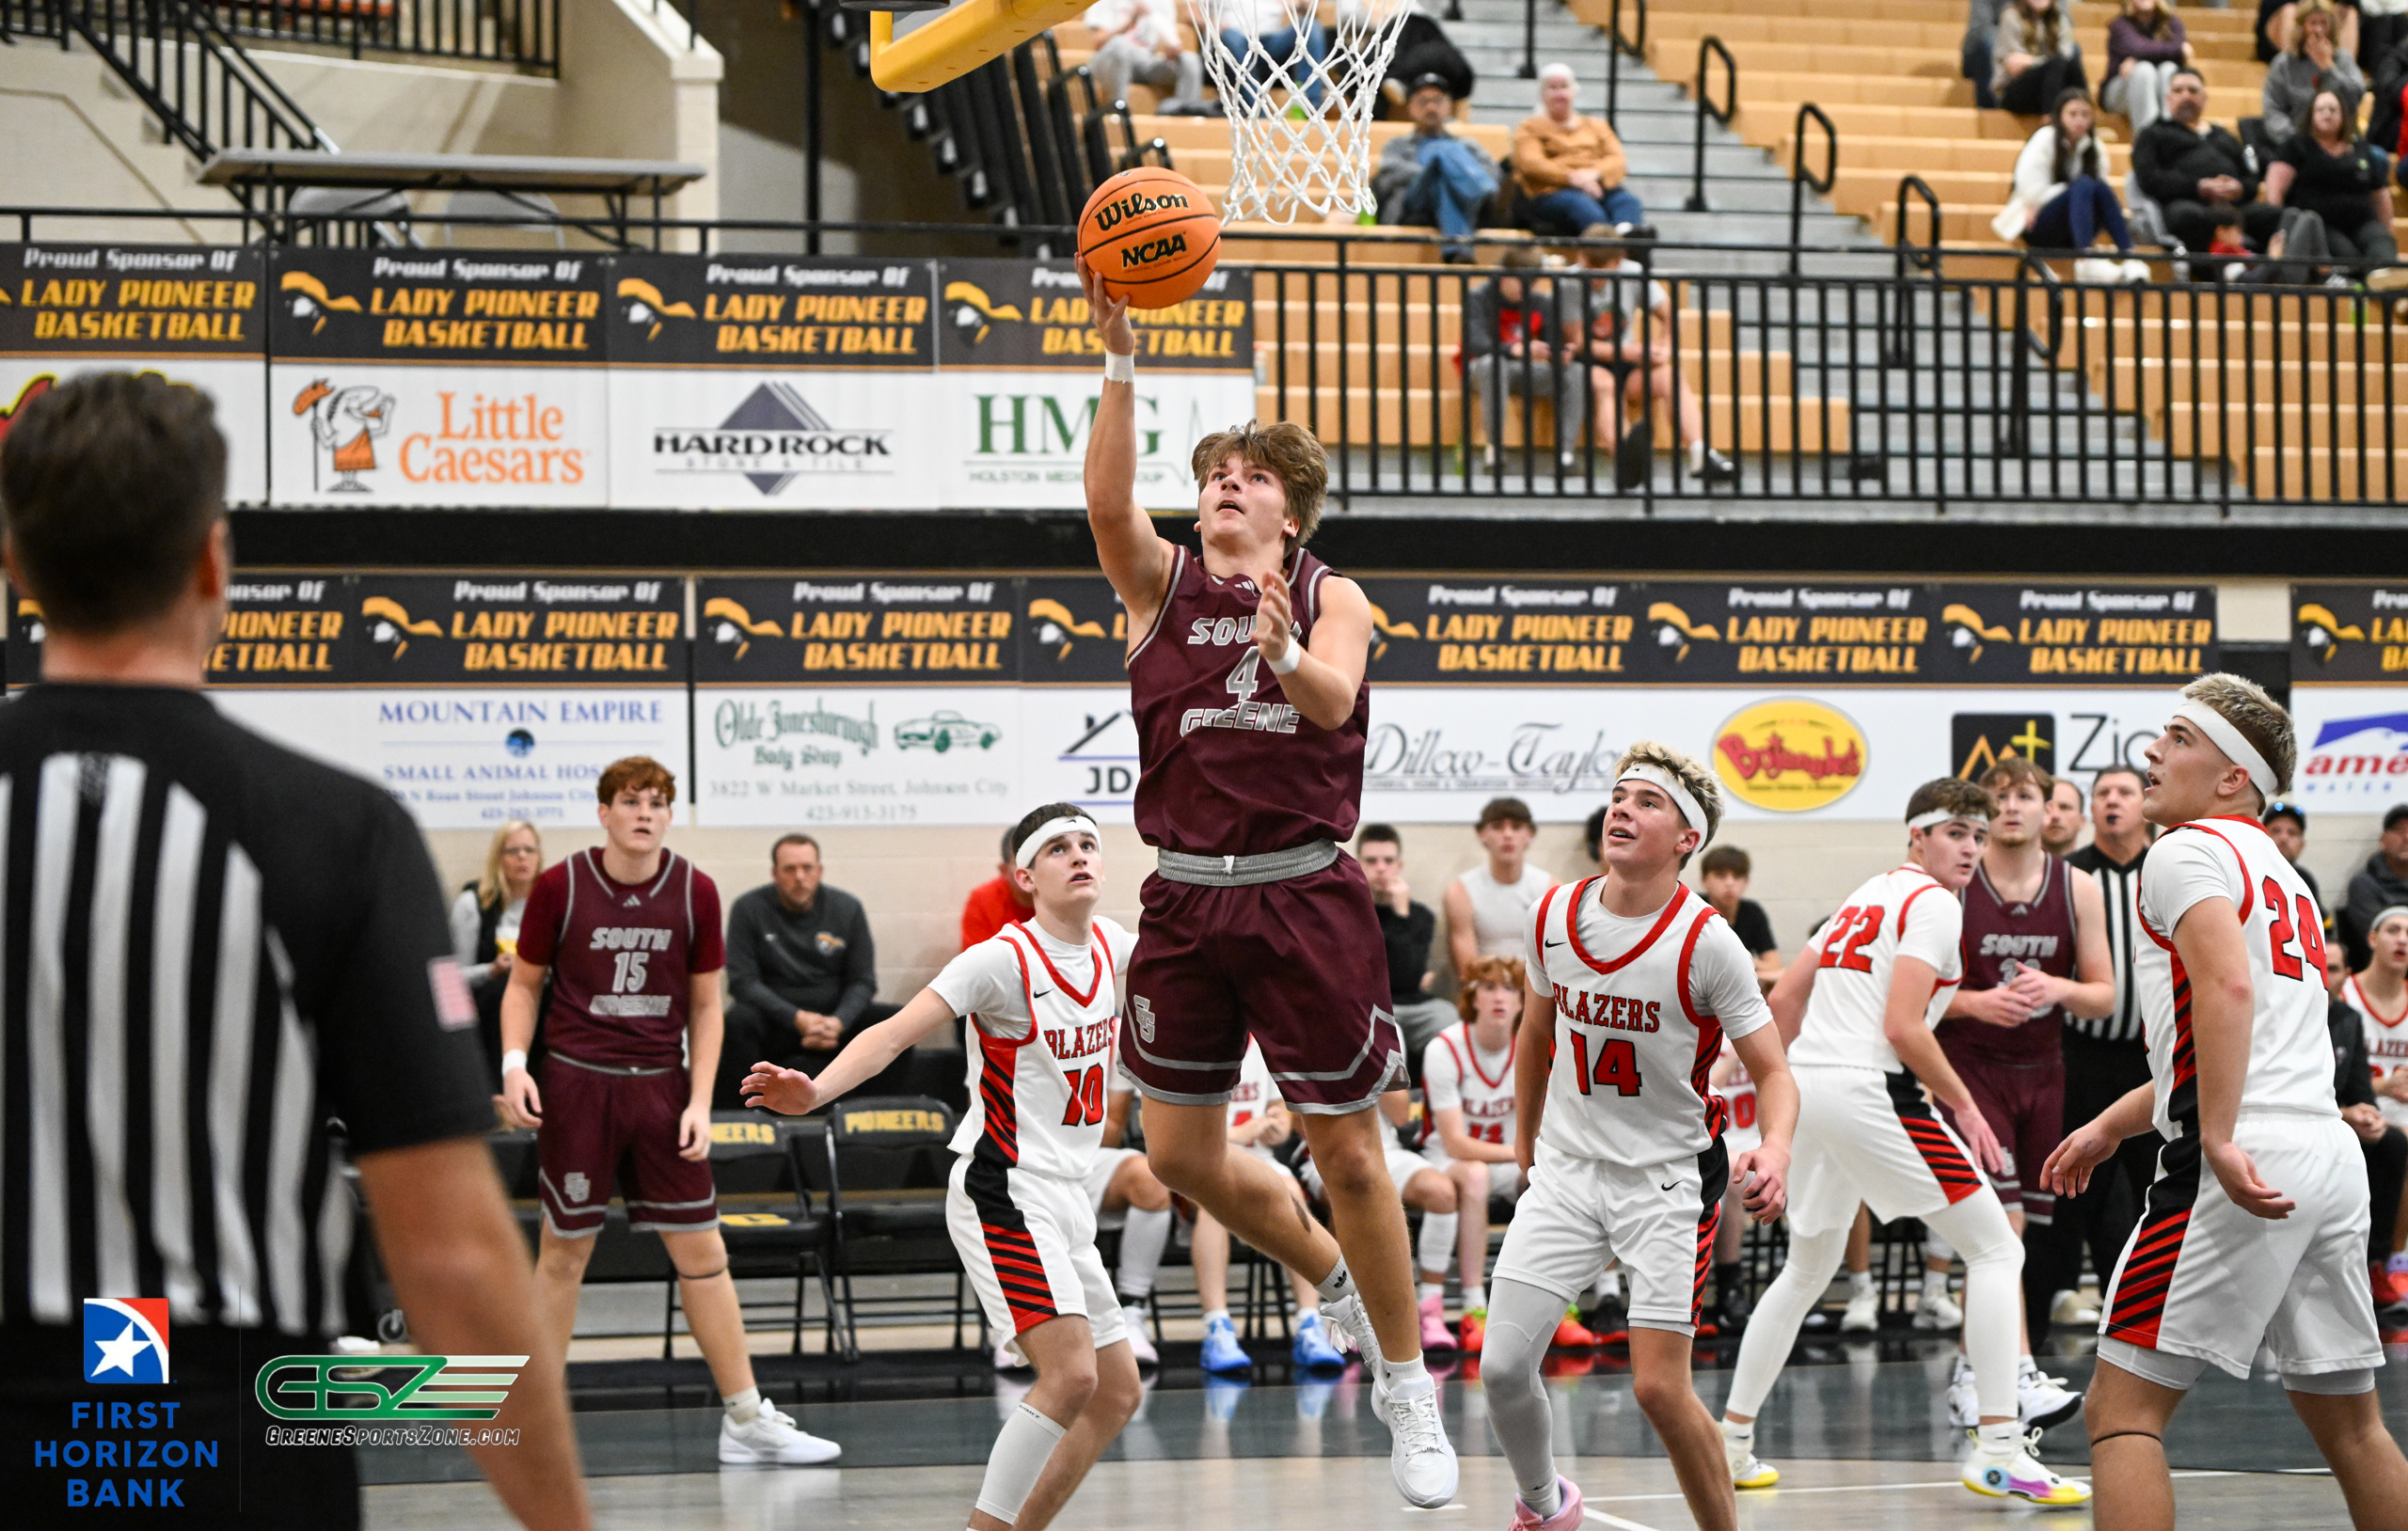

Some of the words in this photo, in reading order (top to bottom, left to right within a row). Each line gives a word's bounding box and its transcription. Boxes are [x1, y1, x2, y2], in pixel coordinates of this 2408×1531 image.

[1095, 193, 1189, 231] Wilson
[24, 247, 100, 269] Proud
[105, 248, 205, 272] Sponsor
[210, 250, 238, 273] Of
[1121, 232, 1187, 268] NCAA
[372, 257, 448, 278] Proud
[452, 258, 550, 281] Sponsor
[554, 260, 584, 282] Of
[705, 263, 779, 285] Proud
[784, 264, 879, 288] Sponsor
[882, 266, 911, 288] Of
[21, 279, 106, 308] LADY
[118, 279, 257, 309] PIONEER
[370, 287, 455, 317] LADY
[464, 289, 600, 319] PIONEER
[704, 293, 786, 322] LADY
[795, 294, 927, 324] PIONEER
[1029, 297, 1091, 324] LAD
[34, 311, 246, 341] BASKETBALL
[382, 319, 590, 350] BASKETBALL
[716, 324, 918, 354] BASKETBALL
[1042, 327, 1237, 357] BASETBALL
[436, 391, 564, 442] Little
[399, 433, 584, 484] Caesars
[654, 434, 773, 456] HARD
[779, 434, 892, 456] ROCK
[297, 580, 326, 603] Of
[453, 580, 528, 602] Proud
[533, 580, 629, 605] Sponsor
[634, 581, 661, 604] Of
[793, 581, 865, 603] Proud
[869, 581, 964, 605] Sponsor
[967, 582, 995, 603] Of
[451, 611, 535, 639] LADY
[544, 611, 679, 639] PIONEER
[790, 611, 873, 639] LADY
[881, 611, 1012, 639] PIONEER
[1426, 614, 1504, 640] LADY
[1511, 614, 1634, 641] PIONEER
[1726, 616, 1801, 643] LADY
[1809, 617, 1927, 643] PIONEER
[2019, 618, 2090, 644] LADY
[2098, 619, 2211, 645] PIONEER
[203, 642, 334, 671] ETBALL
[464, 642, 668, 671] BASKETBALL
[803, 642, 1003, 671] BASKETBALL
[1437, 644, 1624, 671] BASKETBALL
[1738, 646, 1918, 672] BASKETBALL
[2030, 647, 2204, 674] BASKETBALL
[1226, 646, 1260, 702] 4
[378, 700, 547, 723] MOUNTAIN
[561, 700, 662, 722] EMPIRE
[715, 698, 764, 750] Olde
[1180, 701, 1299, 737] GREENE
[2068, 713, 2161, 771] Zio
[383, 764, 453, 781] SMALL
[463, 764, 549, 781] ANIMAL
[1364, 722, 1623, 794] Dillow-Taylo
[756, 780, 771, 796] W
[780, 780, 841, 797] Market
[904, 779, 970, 797] Johnson
[974, 778, 1009, 798] City
[589, 927, 673, 952] SOUTH
[1818, 905, 1885, 974] 22
[1980, 934, 2058, 957] SOUTH
[2261, 875, 2329, 991] 24
[611, 951, 650, 993] 15
[1552, 982, 1660, 1033] BLAZERS
[1044, 1017, 1115, 1060] BLAZERS
[1570, 1028, 1642, 1097] 14
[1061, 1063, 1104, 1127] 10
[844, 1110, 944, 1134] PIONEERS
